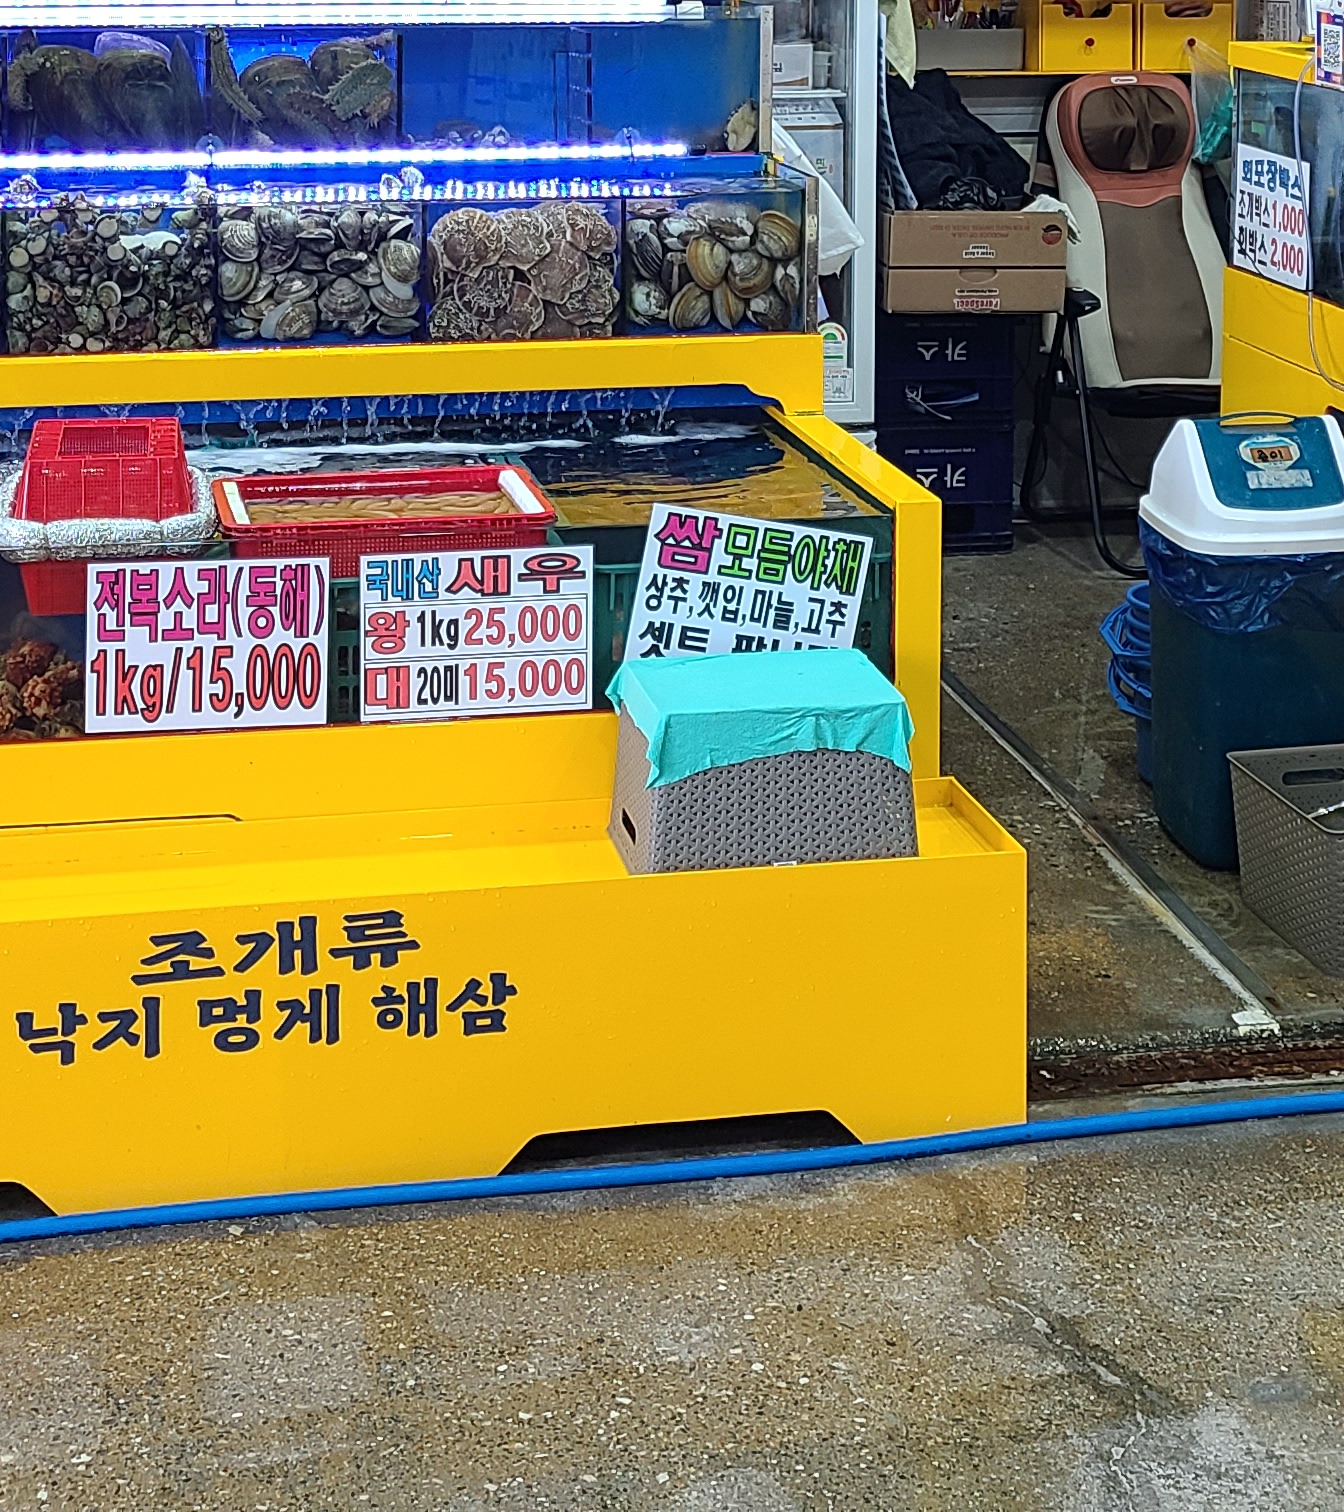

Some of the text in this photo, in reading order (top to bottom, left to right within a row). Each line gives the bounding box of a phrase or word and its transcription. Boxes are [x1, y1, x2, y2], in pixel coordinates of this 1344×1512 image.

[1242, 159, 1302, 201] 회포장박스
[1238, 190, 1305, 238] 조개박스 1,000
[1238, 226, 1303, 277] 회박스 2,000
[917, 338, 967, 361] 카스
[916, 464, 966, 488] 카스
[365, 552, 587, 601] 국내산 새우
[654, 512, 866, 596] 쌈 모듬야채
[92, 564, 326, 645] 전복소라(동해)
[365, 603, 582, 656] 왕 1kg 25,000
[638, 620, 710, 658] 셋트
[91, 644, 320, 724] 1kg/15,000
[365, 658, 586, 712] 대 20미 15,000
[130, 910, 420, 986] 조개류
[15, 972, 519, 1067] 낙지 멍게 해삼
